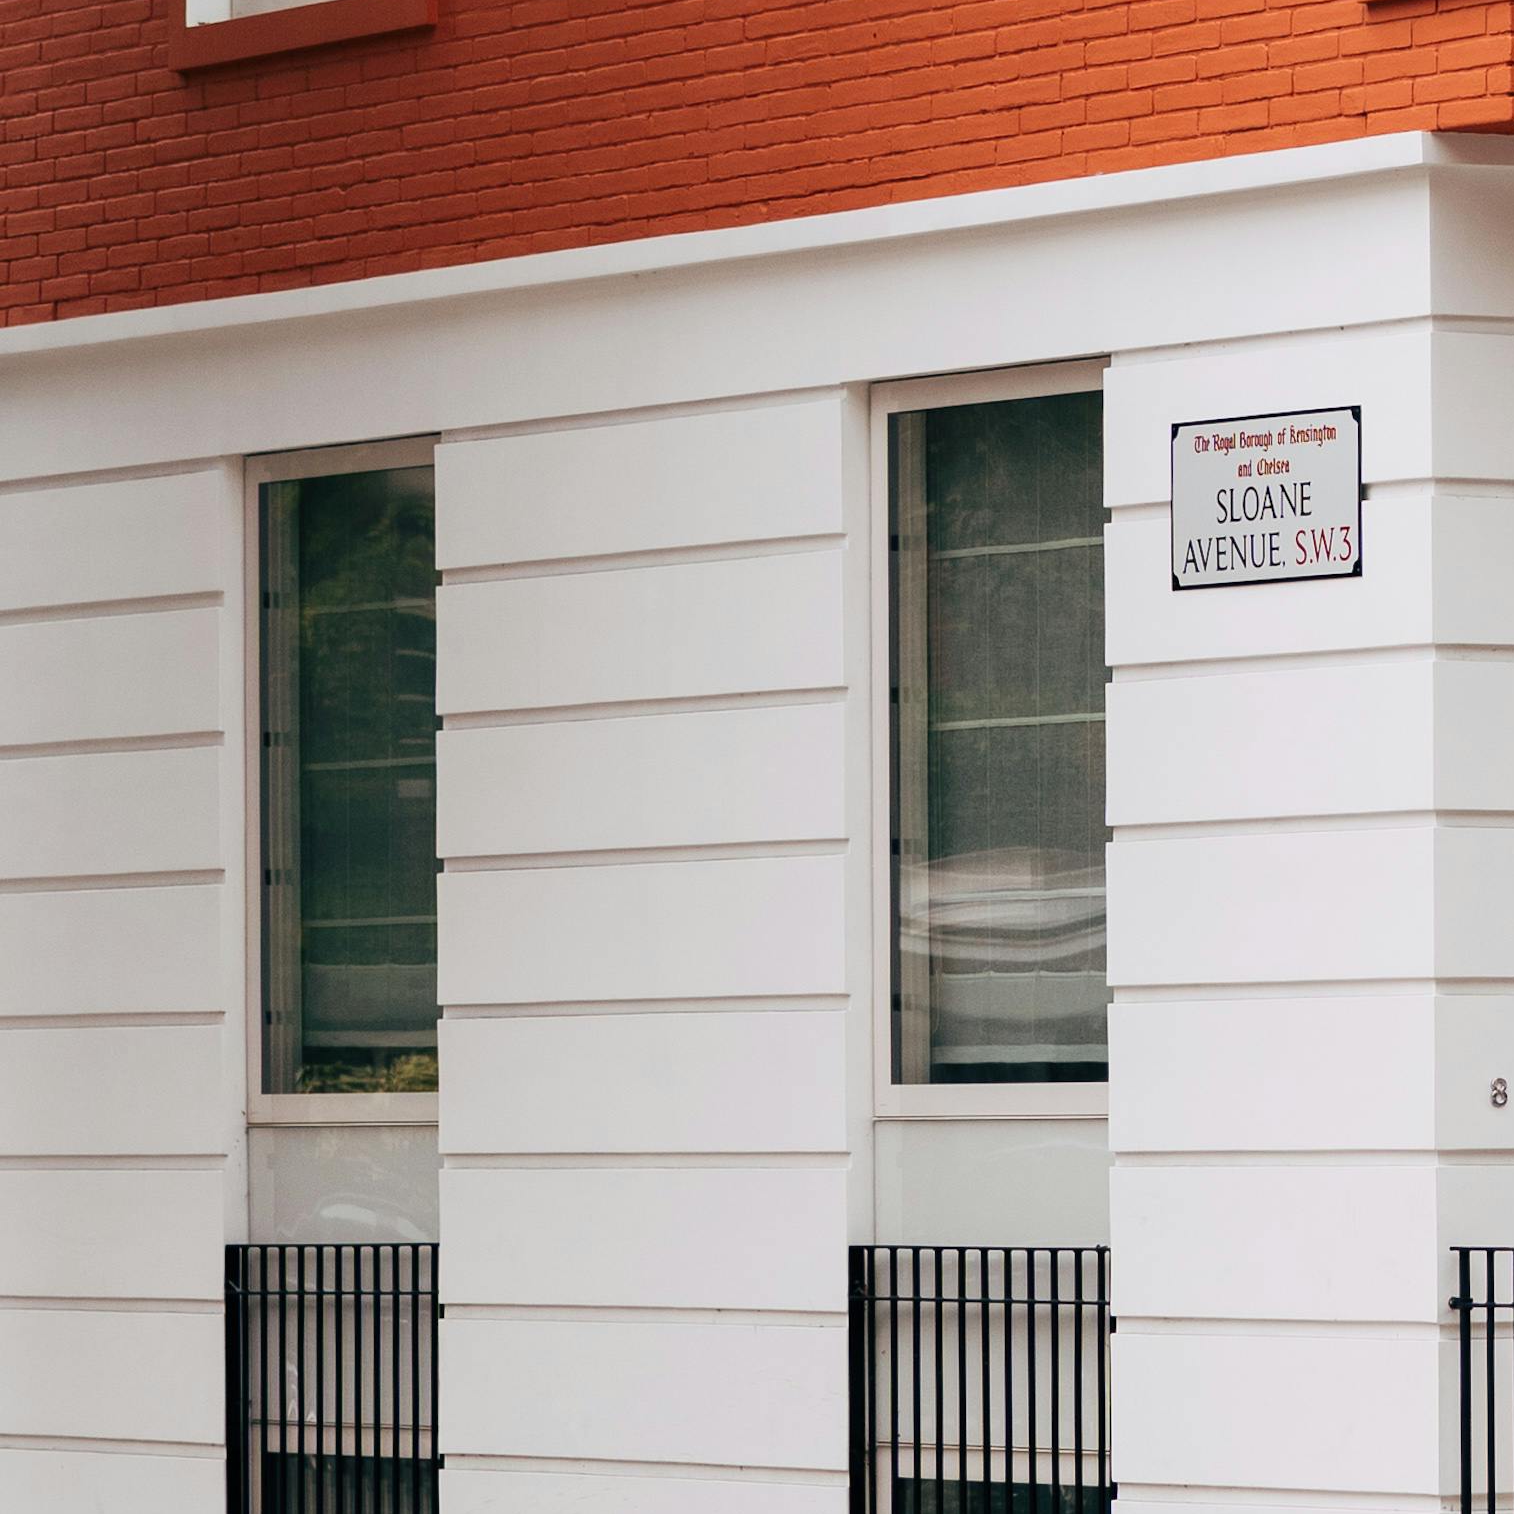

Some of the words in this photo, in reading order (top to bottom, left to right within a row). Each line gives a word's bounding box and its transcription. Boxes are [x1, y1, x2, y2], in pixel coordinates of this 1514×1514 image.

[1194, 435, 1210, 454] The
[1212, 432, 1236, 456] Royal
[1239, 430, 1273, 452] Borough
[1277, 427, 1287, 446] of
[1289, 424, 1337, 447] Kensington
[1238, 459, 1252, 477] and
[1256, 458, 1290, 476] Chelsea
[1216, 481, 1312, 524] SLOANE
[1182, 531, 1286, 575] AVENUE,
[1295, 526, 1352, 566] S.W.3
[1490, 1077, 1508, 1108] 8
